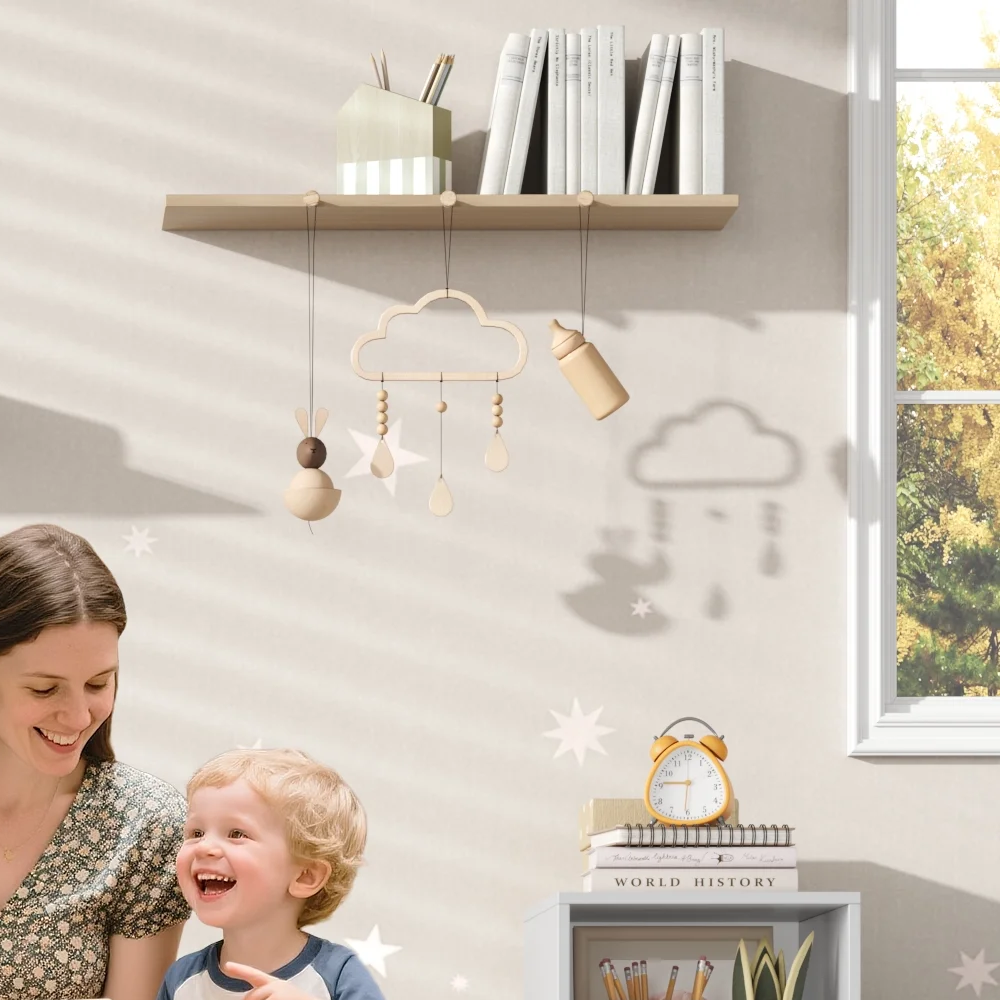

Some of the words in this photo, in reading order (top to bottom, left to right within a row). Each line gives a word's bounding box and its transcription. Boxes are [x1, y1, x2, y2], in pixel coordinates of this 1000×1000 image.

[707, 770, 712, 778] 2
[713, 783, 718, 791] 3
[657, 797, 663, 805] 8
[685, 808, 691, 816] 6
[702, 805, 707, 813] 5
[614, 877, 681, 887] WORLD
[694, 877, 776, 887] HISTORY
